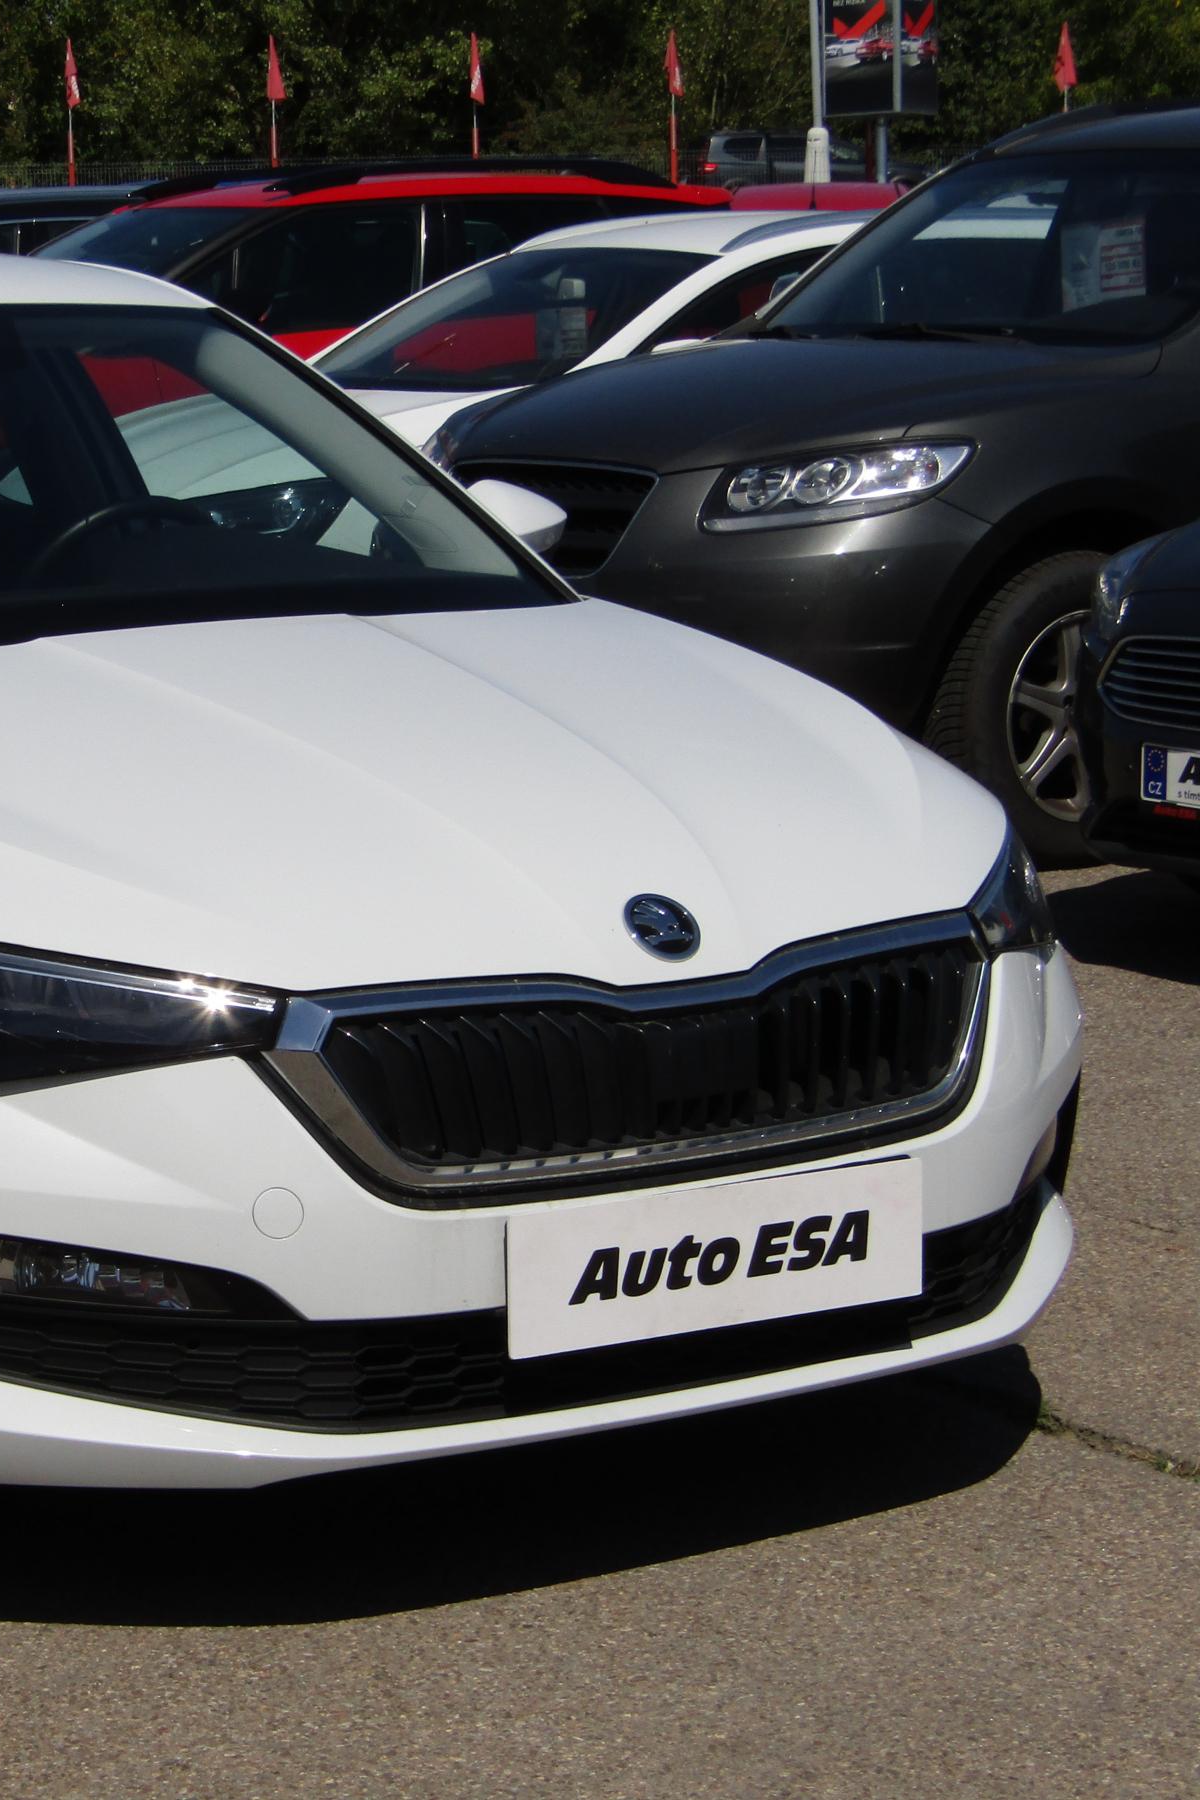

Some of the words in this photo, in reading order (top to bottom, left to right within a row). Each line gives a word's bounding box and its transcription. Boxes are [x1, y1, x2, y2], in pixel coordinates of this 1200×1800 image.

[1148, 781, 1162, 795] CZ
[568, 1235, 740, 1306] Auto
[747, 1210, 870, 1278] ESA
